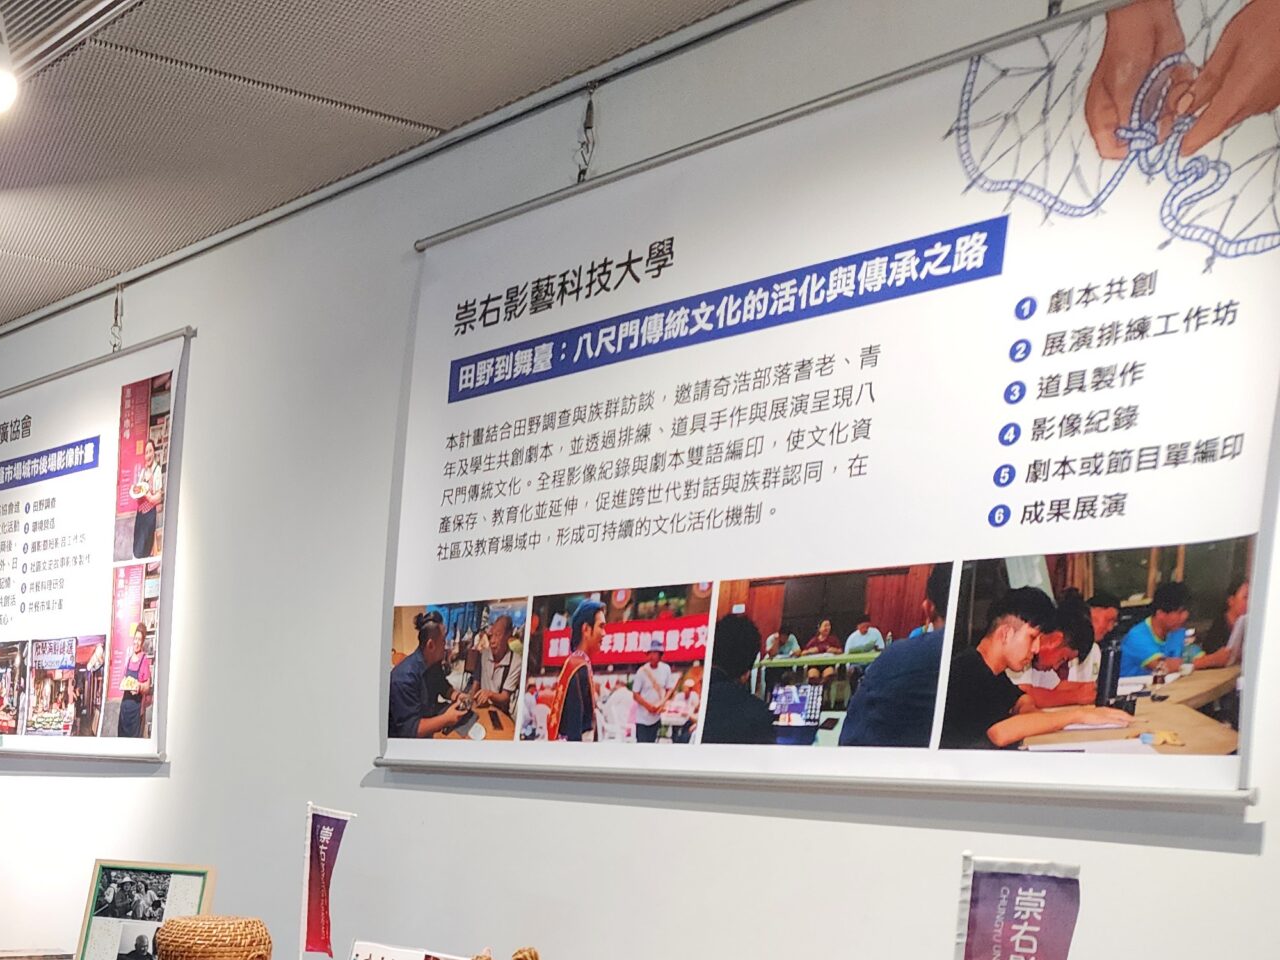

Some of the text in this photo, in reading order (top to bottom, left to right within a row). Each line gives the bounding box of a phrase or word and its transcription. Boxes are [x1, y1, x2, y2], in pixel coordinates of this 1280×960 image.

[454, 237, 674, 336] 崇右影藝科技大學
[1046, 269, 1158, 314] 劇本共創
[458, 231, 988, 392] 田野到舞臺：八尺門傳統文化的活化與傳承之路
[1041, 299, 1239, 357] 展演排練工作坊
[1036, 361, 1146, 400] 道具製作
[1031, 405, 1139, 442] 影像紀錄
[1025, 433, 1244, 484] 劇本或節目單編印
[1020, 492, 1127, 525] 成果展演
